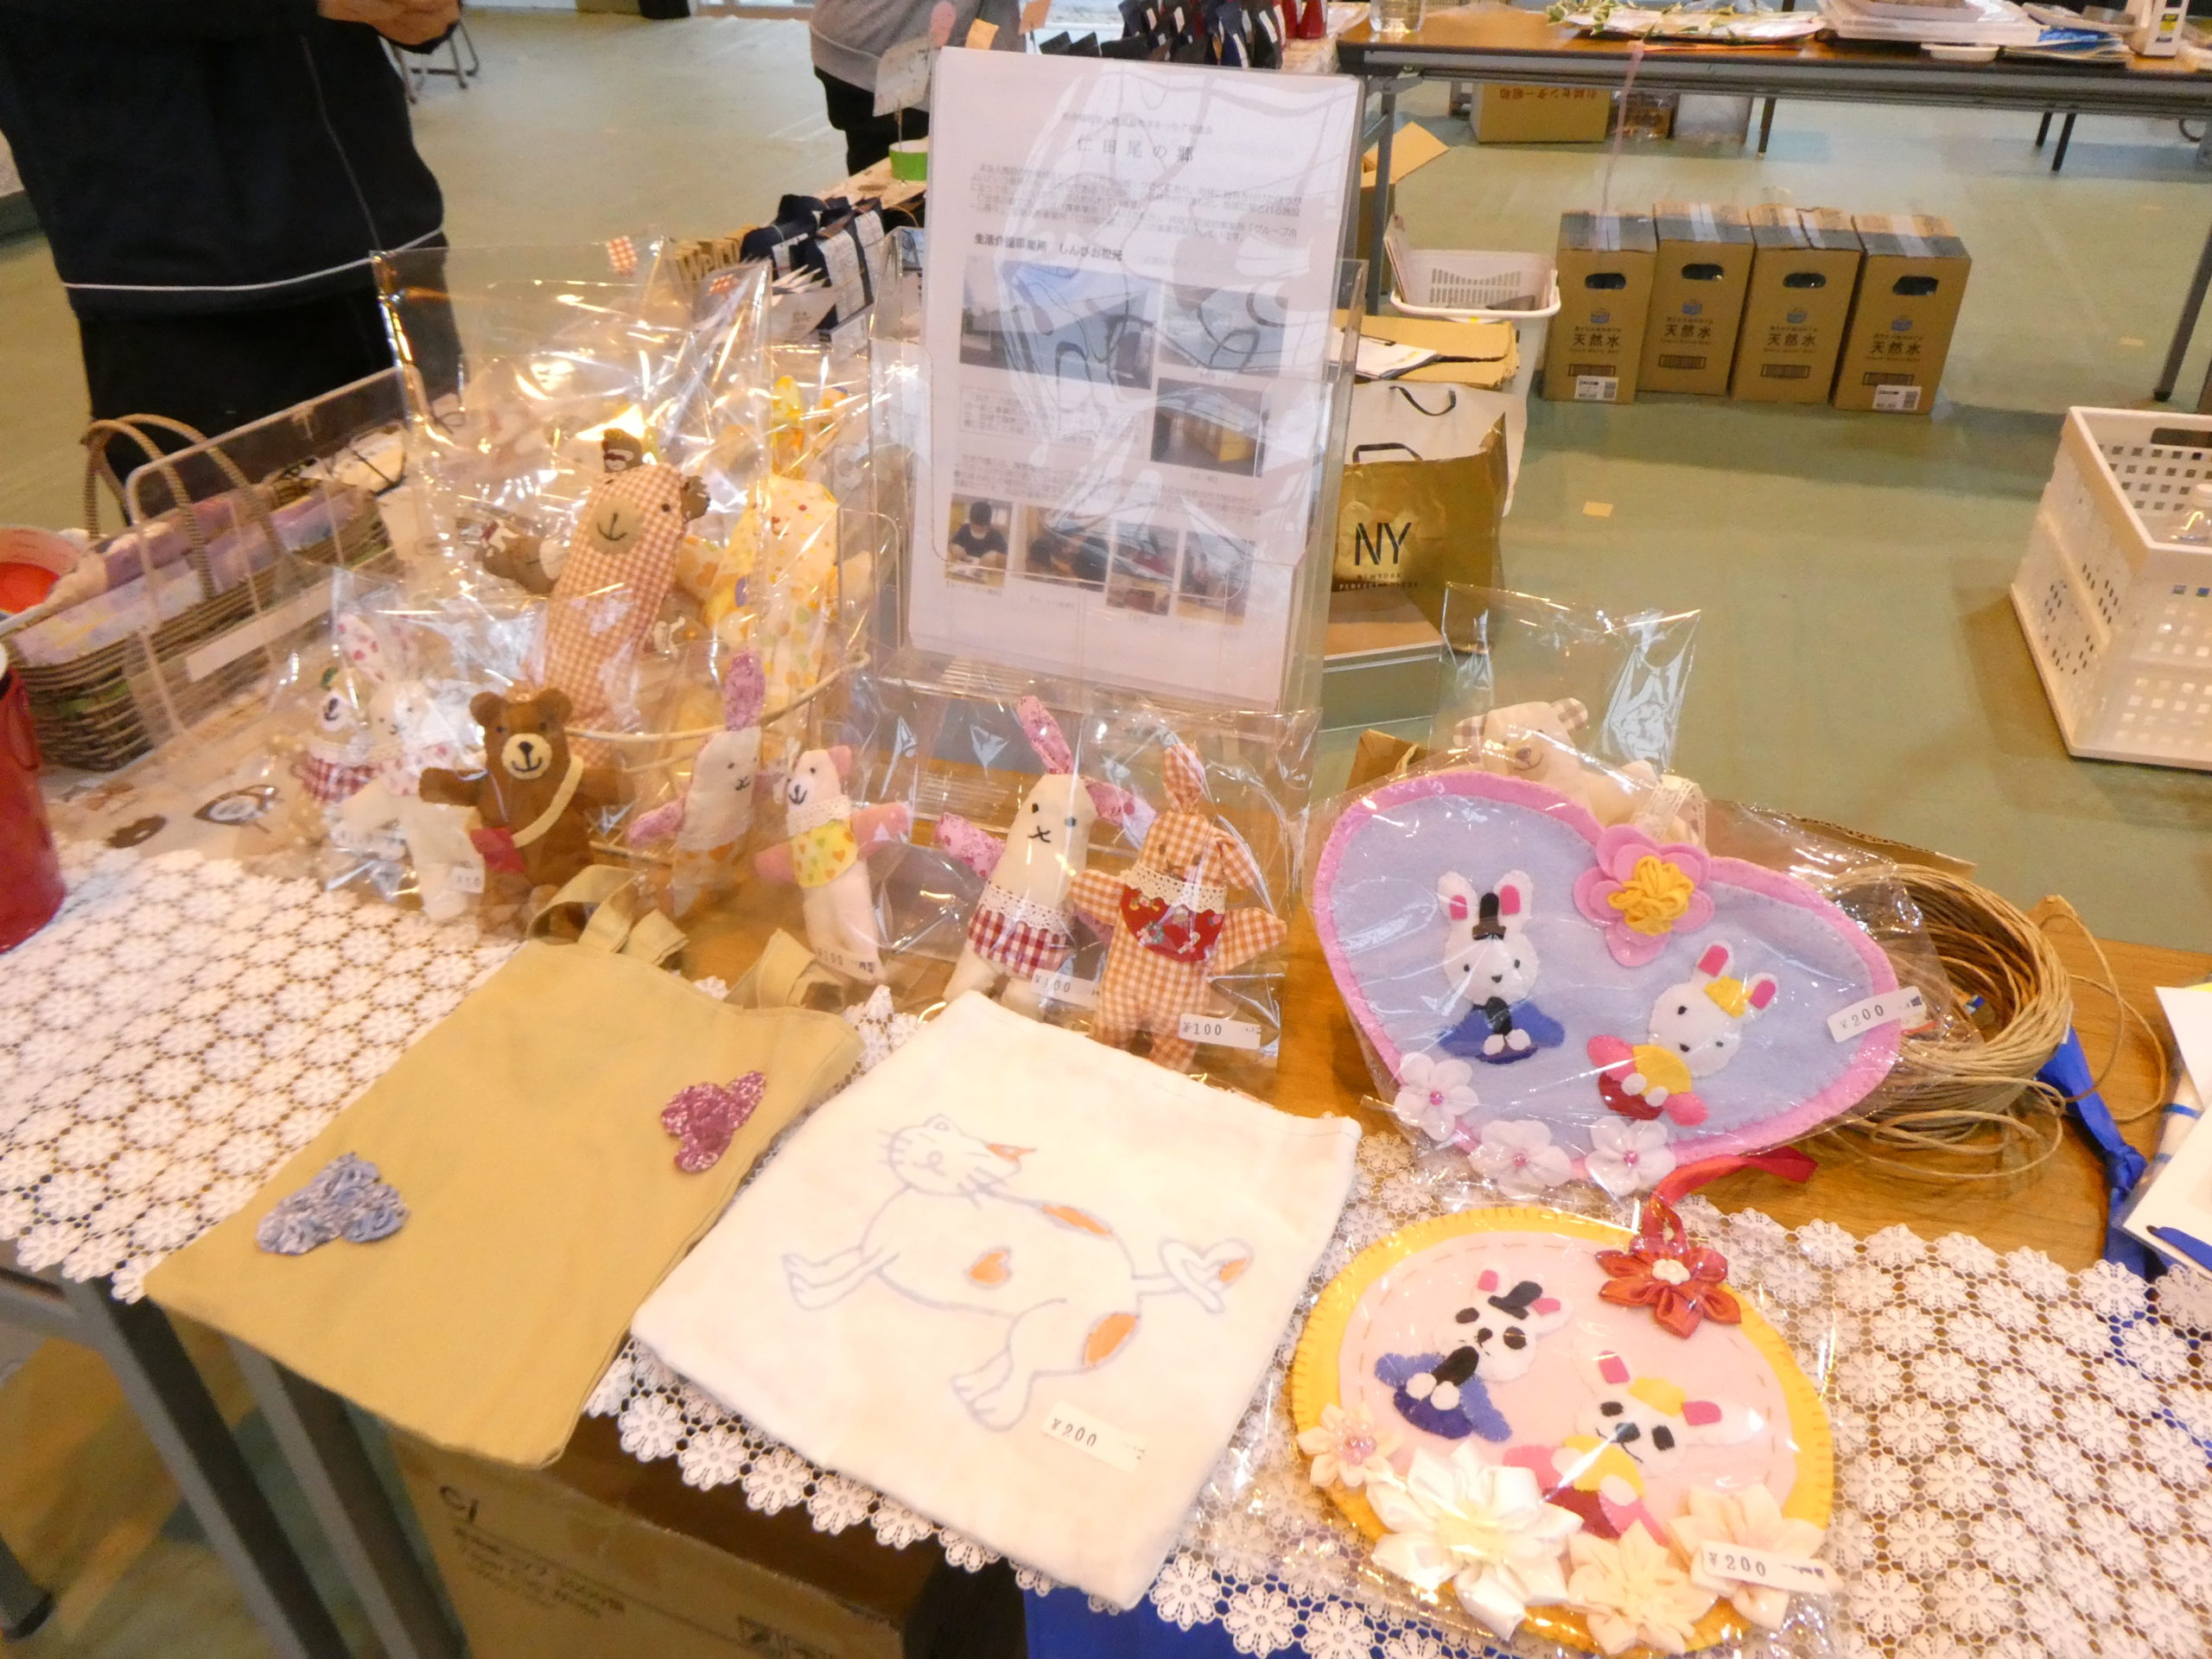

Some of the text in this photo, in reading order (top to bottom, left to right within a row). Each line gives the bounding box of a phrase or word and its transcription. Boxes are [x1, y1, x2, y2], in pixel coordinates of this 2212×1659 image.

[1664, 323, 1713, 340] 天然水
[1768, 333, 1816, 346] 天然水
[1573, 333, 1620, 347] 天然水
[1870, 340, 1922, 355] 天然水
[1355, 522, 1413, 566] NY
[1840, 1004, 1885, 1029] ¥200
[1182, 1021, 1223, 1036] ¥100
[1708, 1551, 1767, 1578] ¥200
